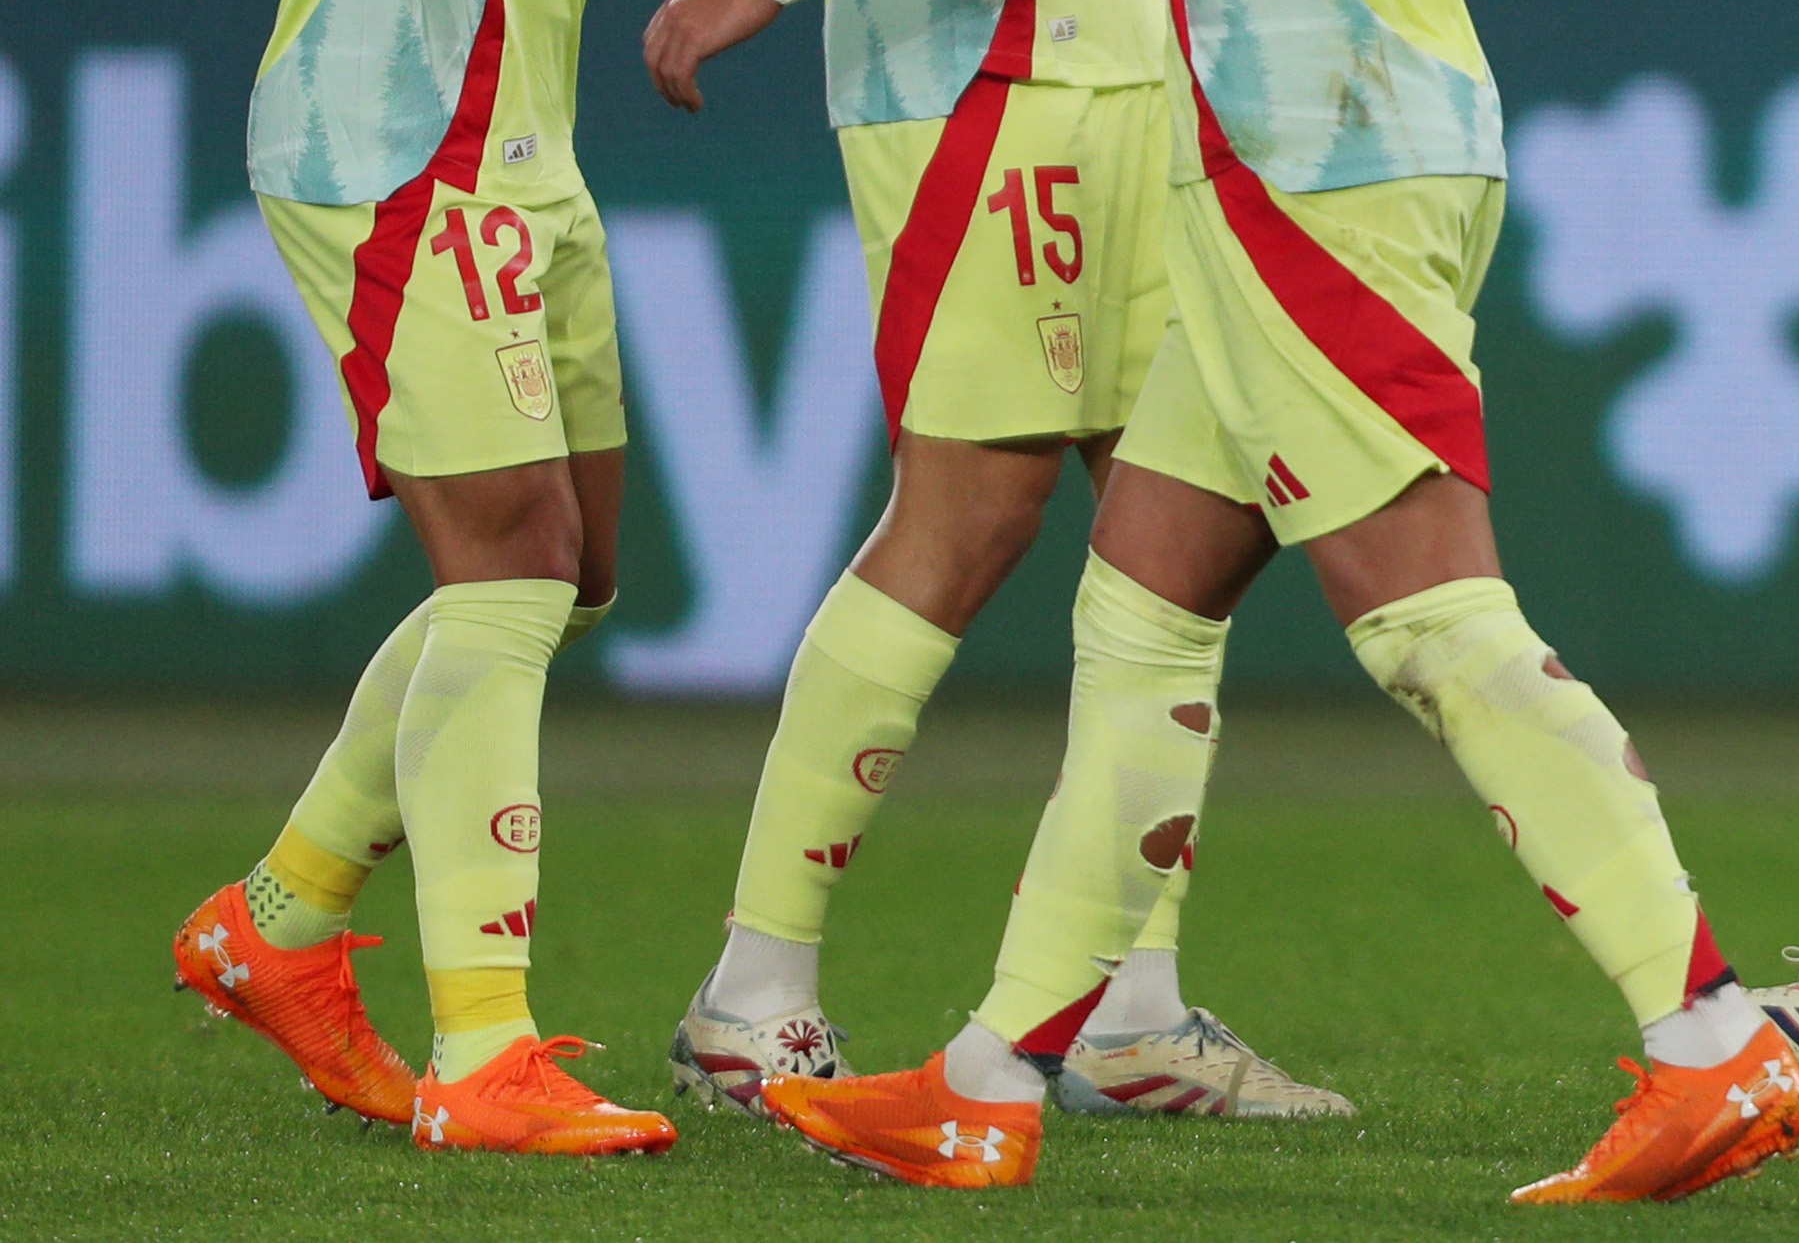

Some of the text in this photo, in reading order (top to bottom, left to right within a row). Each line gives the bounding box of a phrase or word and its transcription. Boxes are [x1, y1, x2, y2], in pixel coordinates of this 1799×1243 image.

[430, 206, 542, 321] 12
[987, 165, 1083, 286] 15
[0, 47, 890, 693] by
